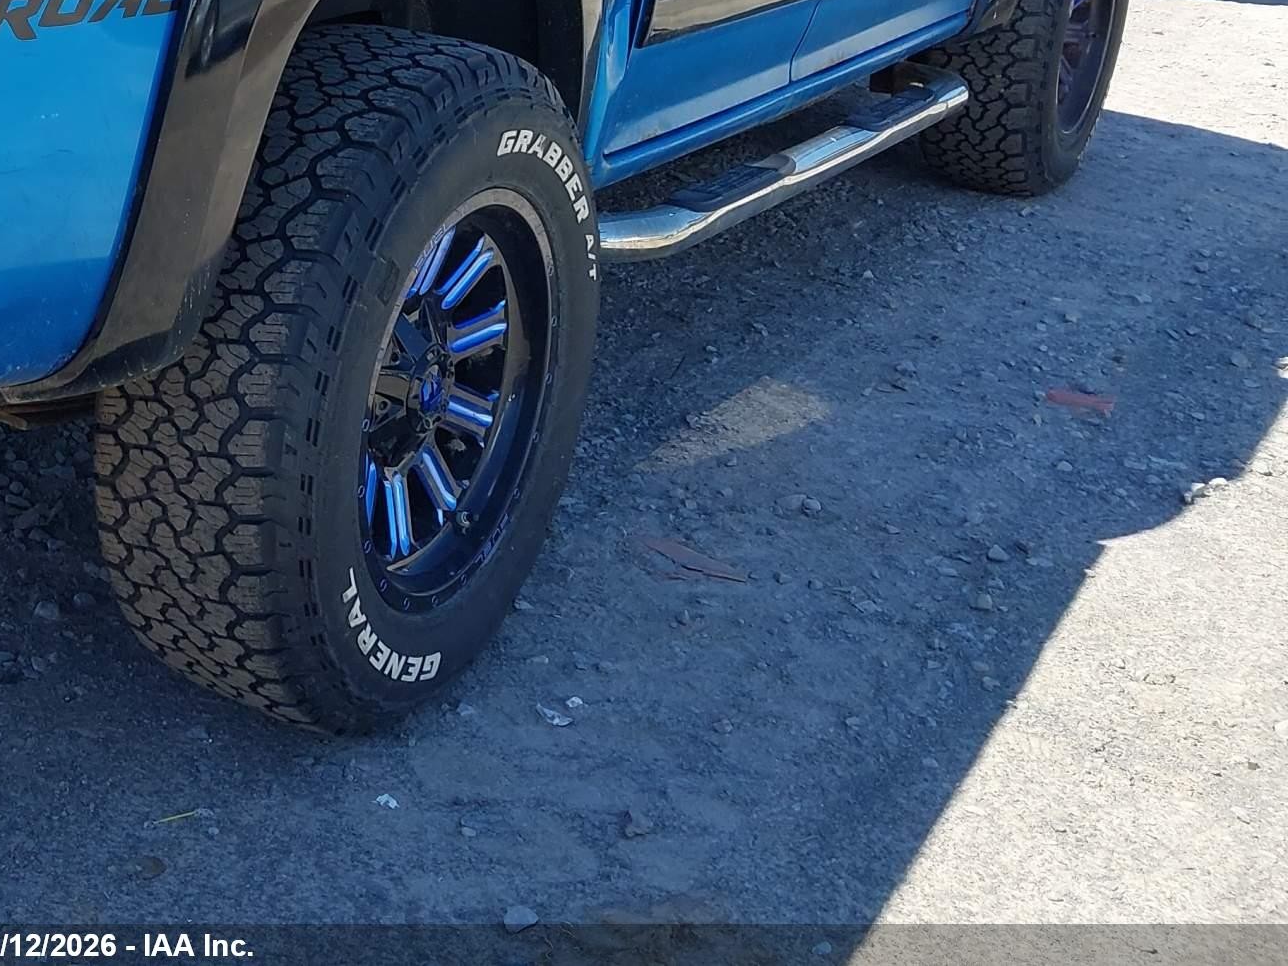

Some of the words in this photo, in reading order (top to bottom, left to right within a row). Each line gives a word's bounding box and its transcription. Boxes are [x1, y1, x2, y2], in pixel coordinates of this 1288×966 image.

[497, 129, 590, 224] GRABBER
[585, 234, 597, 281] A/T
[342, 567, 441, 682] GENERAL
